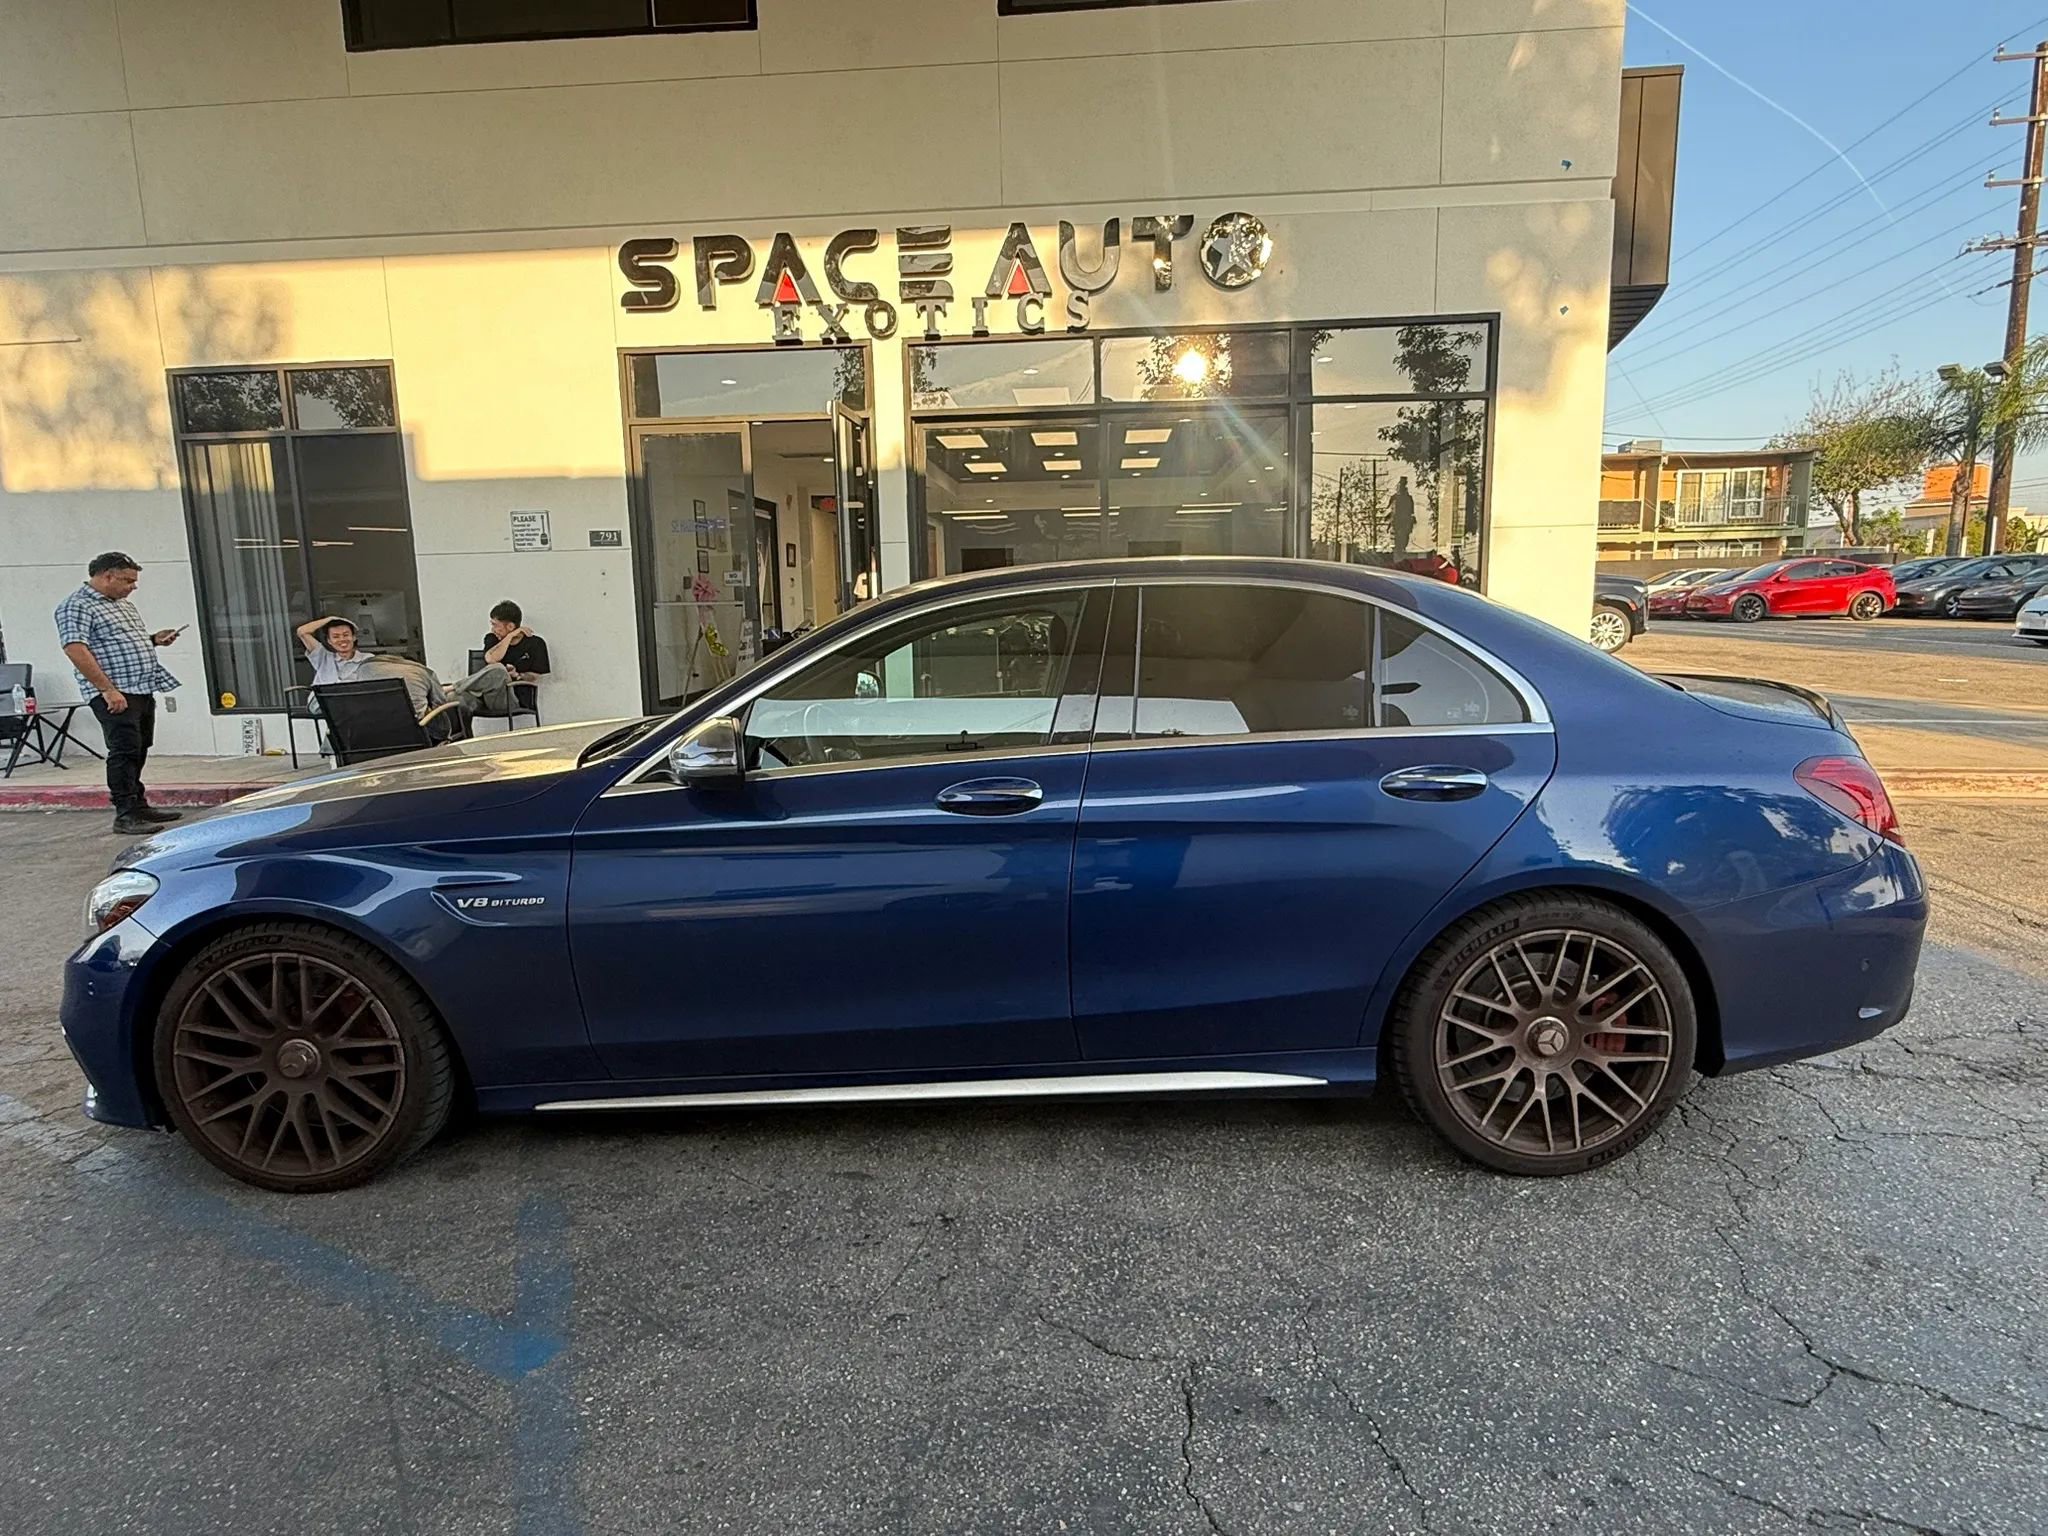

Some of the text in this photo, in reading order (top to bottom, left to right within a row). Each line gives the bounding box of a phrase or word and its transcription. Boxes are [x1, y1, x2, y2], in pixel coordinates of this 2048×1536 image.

[618, 212, 1274, 313] SPACE AUTO
[772, 291, 1091, 346] EXOTICS
[600, 532, 618, 541] 791
[457, 897, 545, 908] V8 BITURBO
